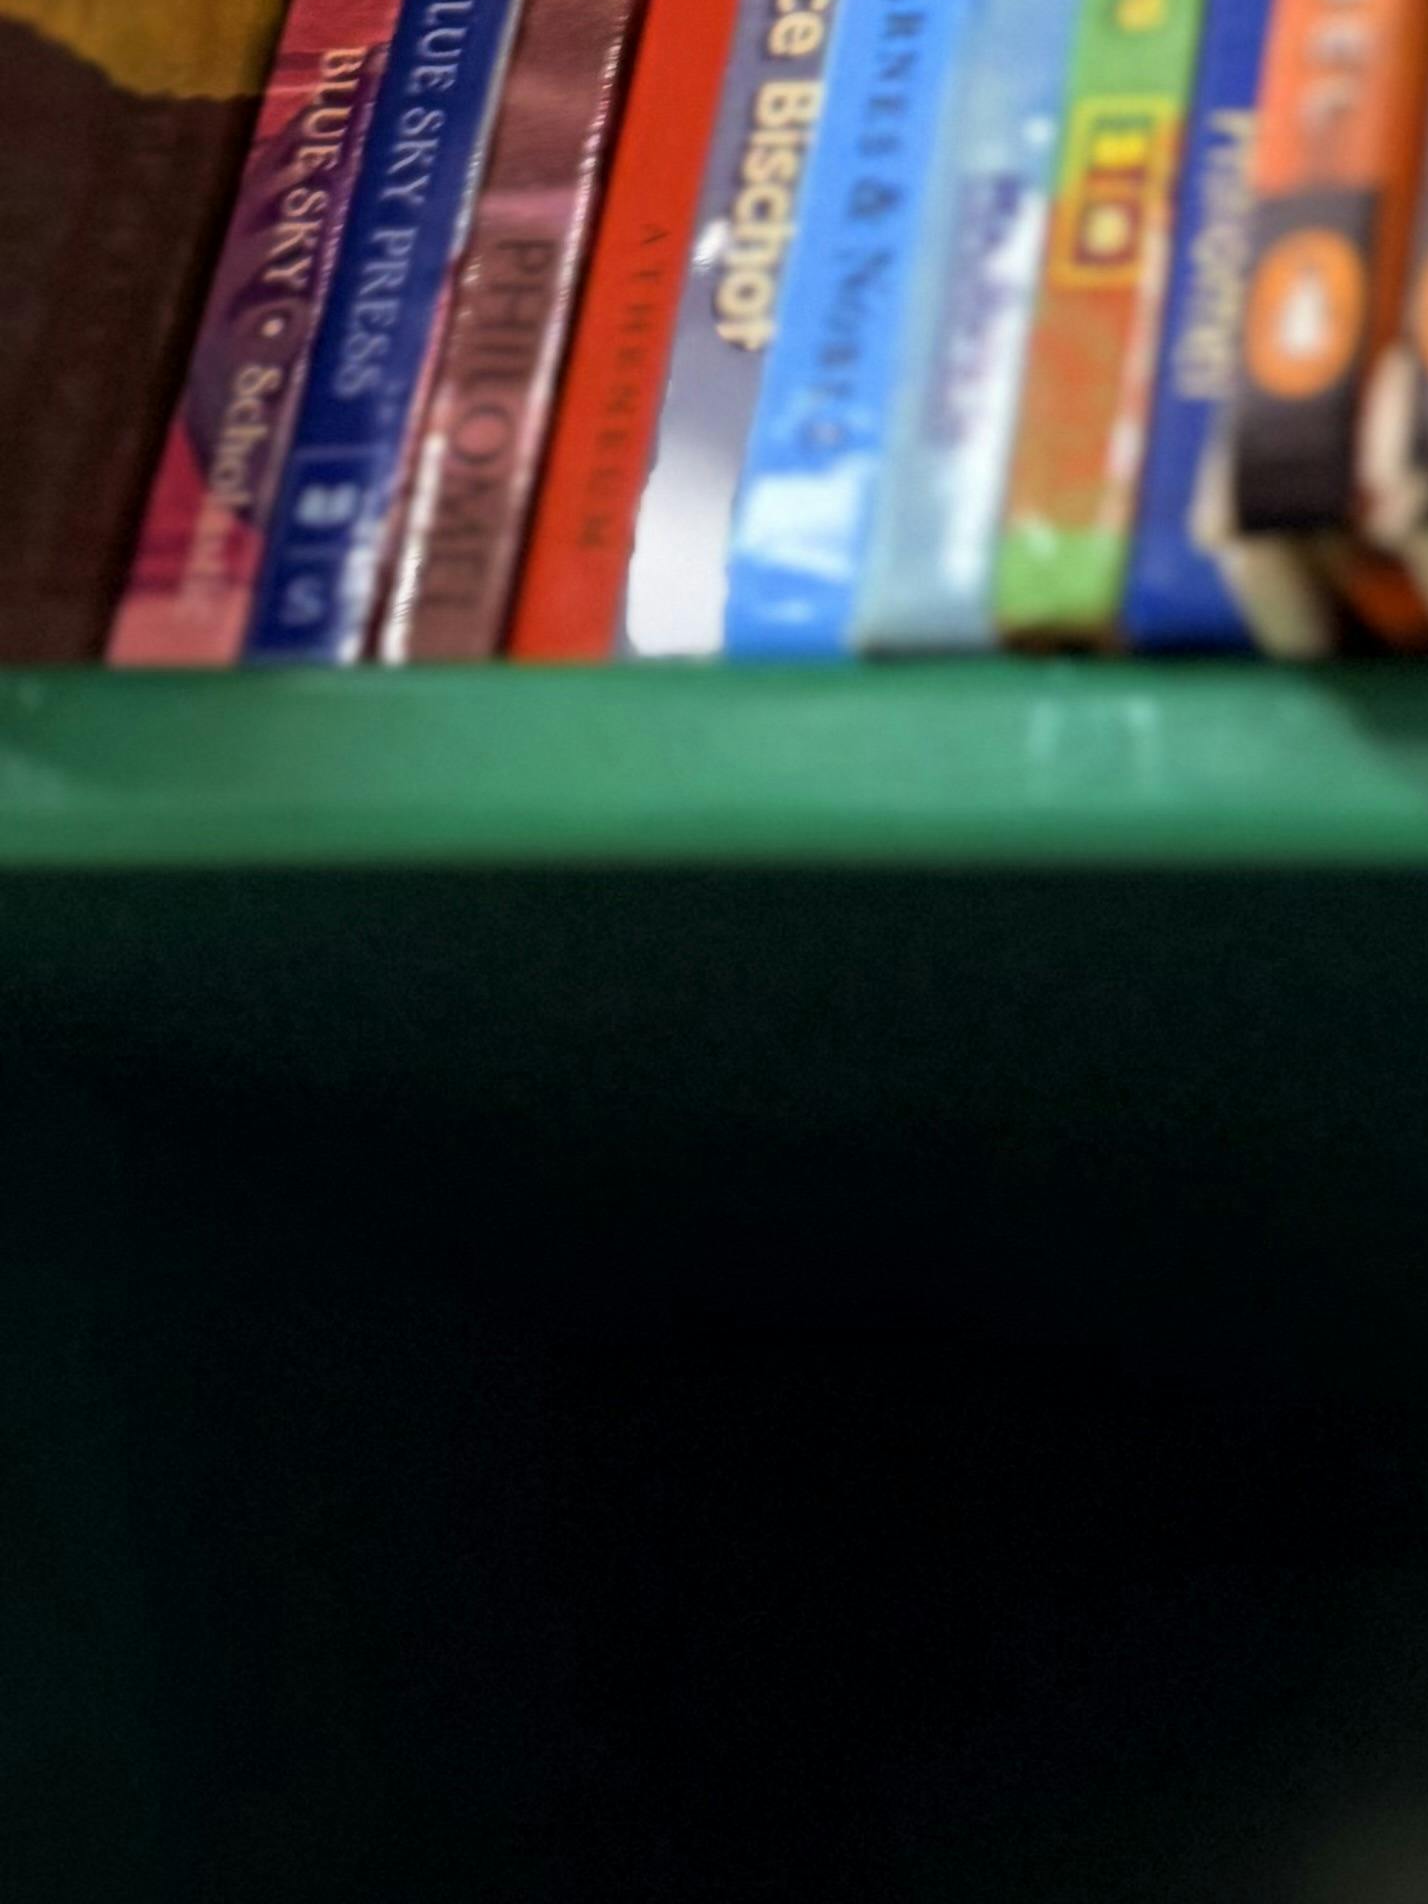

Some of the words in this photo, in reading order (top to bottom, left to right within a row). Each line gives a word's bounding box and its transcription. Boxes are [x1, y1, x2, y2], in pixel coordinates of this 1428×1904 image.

[292, 44, 369, 194] BLUE
[380, 105, 448, 209] SKY
[262, 184, 330, 287] SKY
[716, 76, 824, 352] Bischof
[333, 223, 418, 400] PRESS
